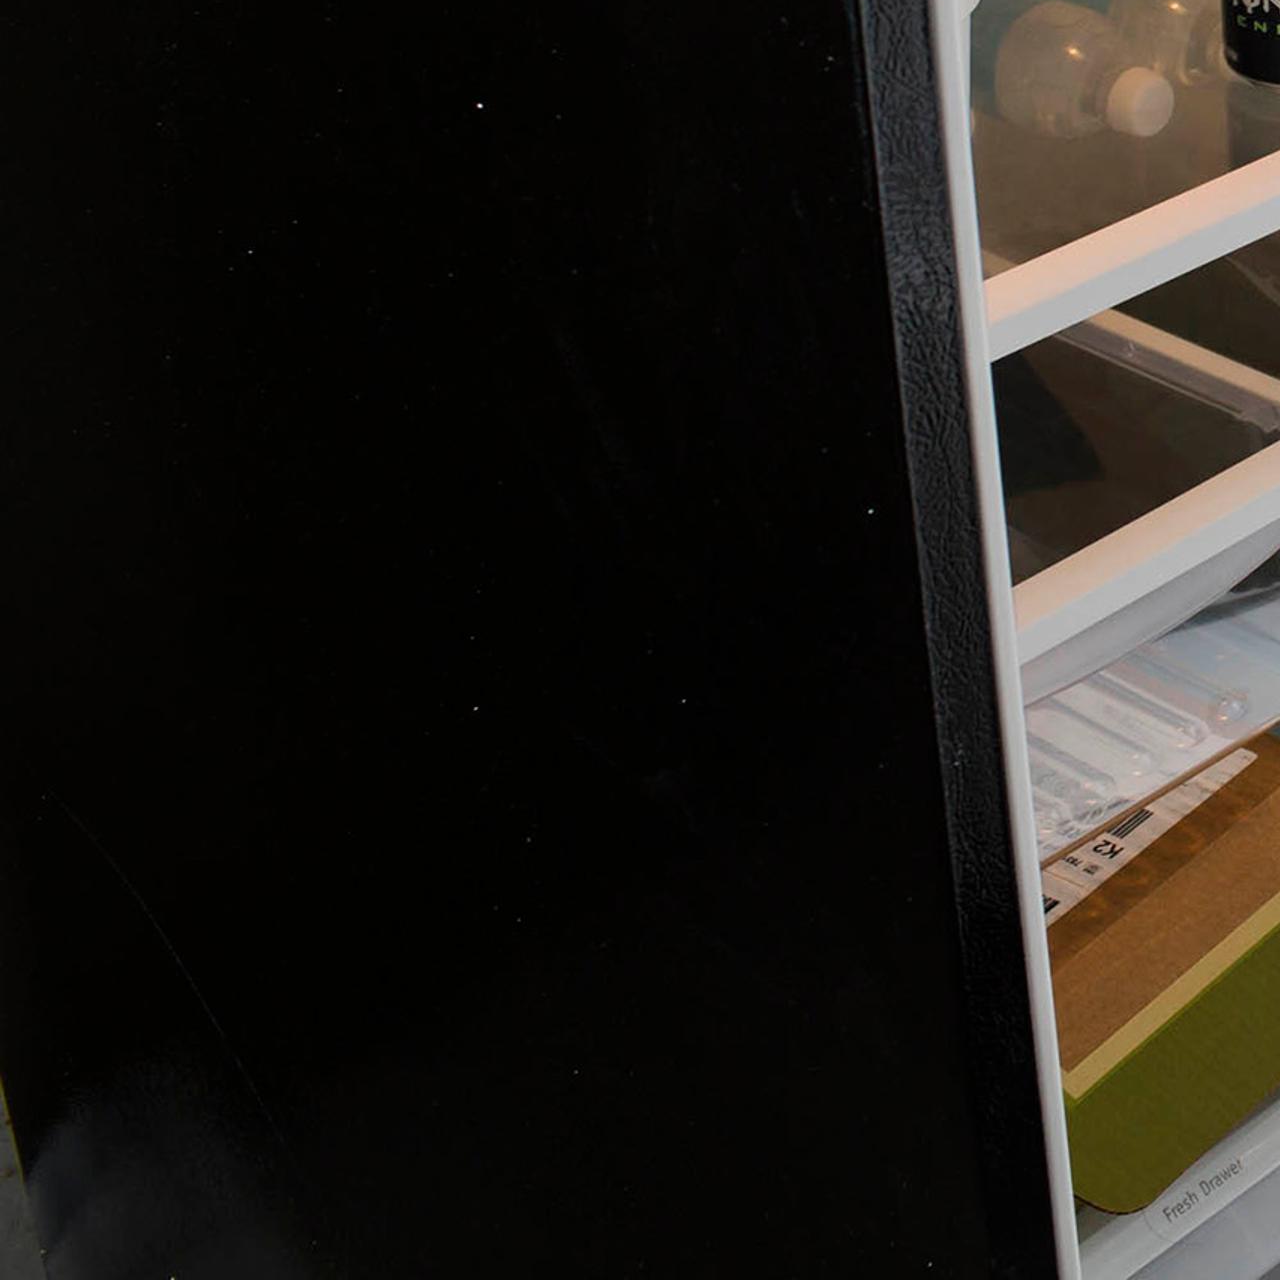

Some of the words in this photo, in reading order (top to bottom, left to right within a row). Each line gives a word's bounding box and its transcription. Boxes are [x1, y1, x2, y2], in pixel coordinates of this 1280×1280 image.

[1092, 839, 1124, 860] K2
[1162, 1190, 1200, 1223] Fresh
[1199, 1159, 1243, 1197] Drawer
